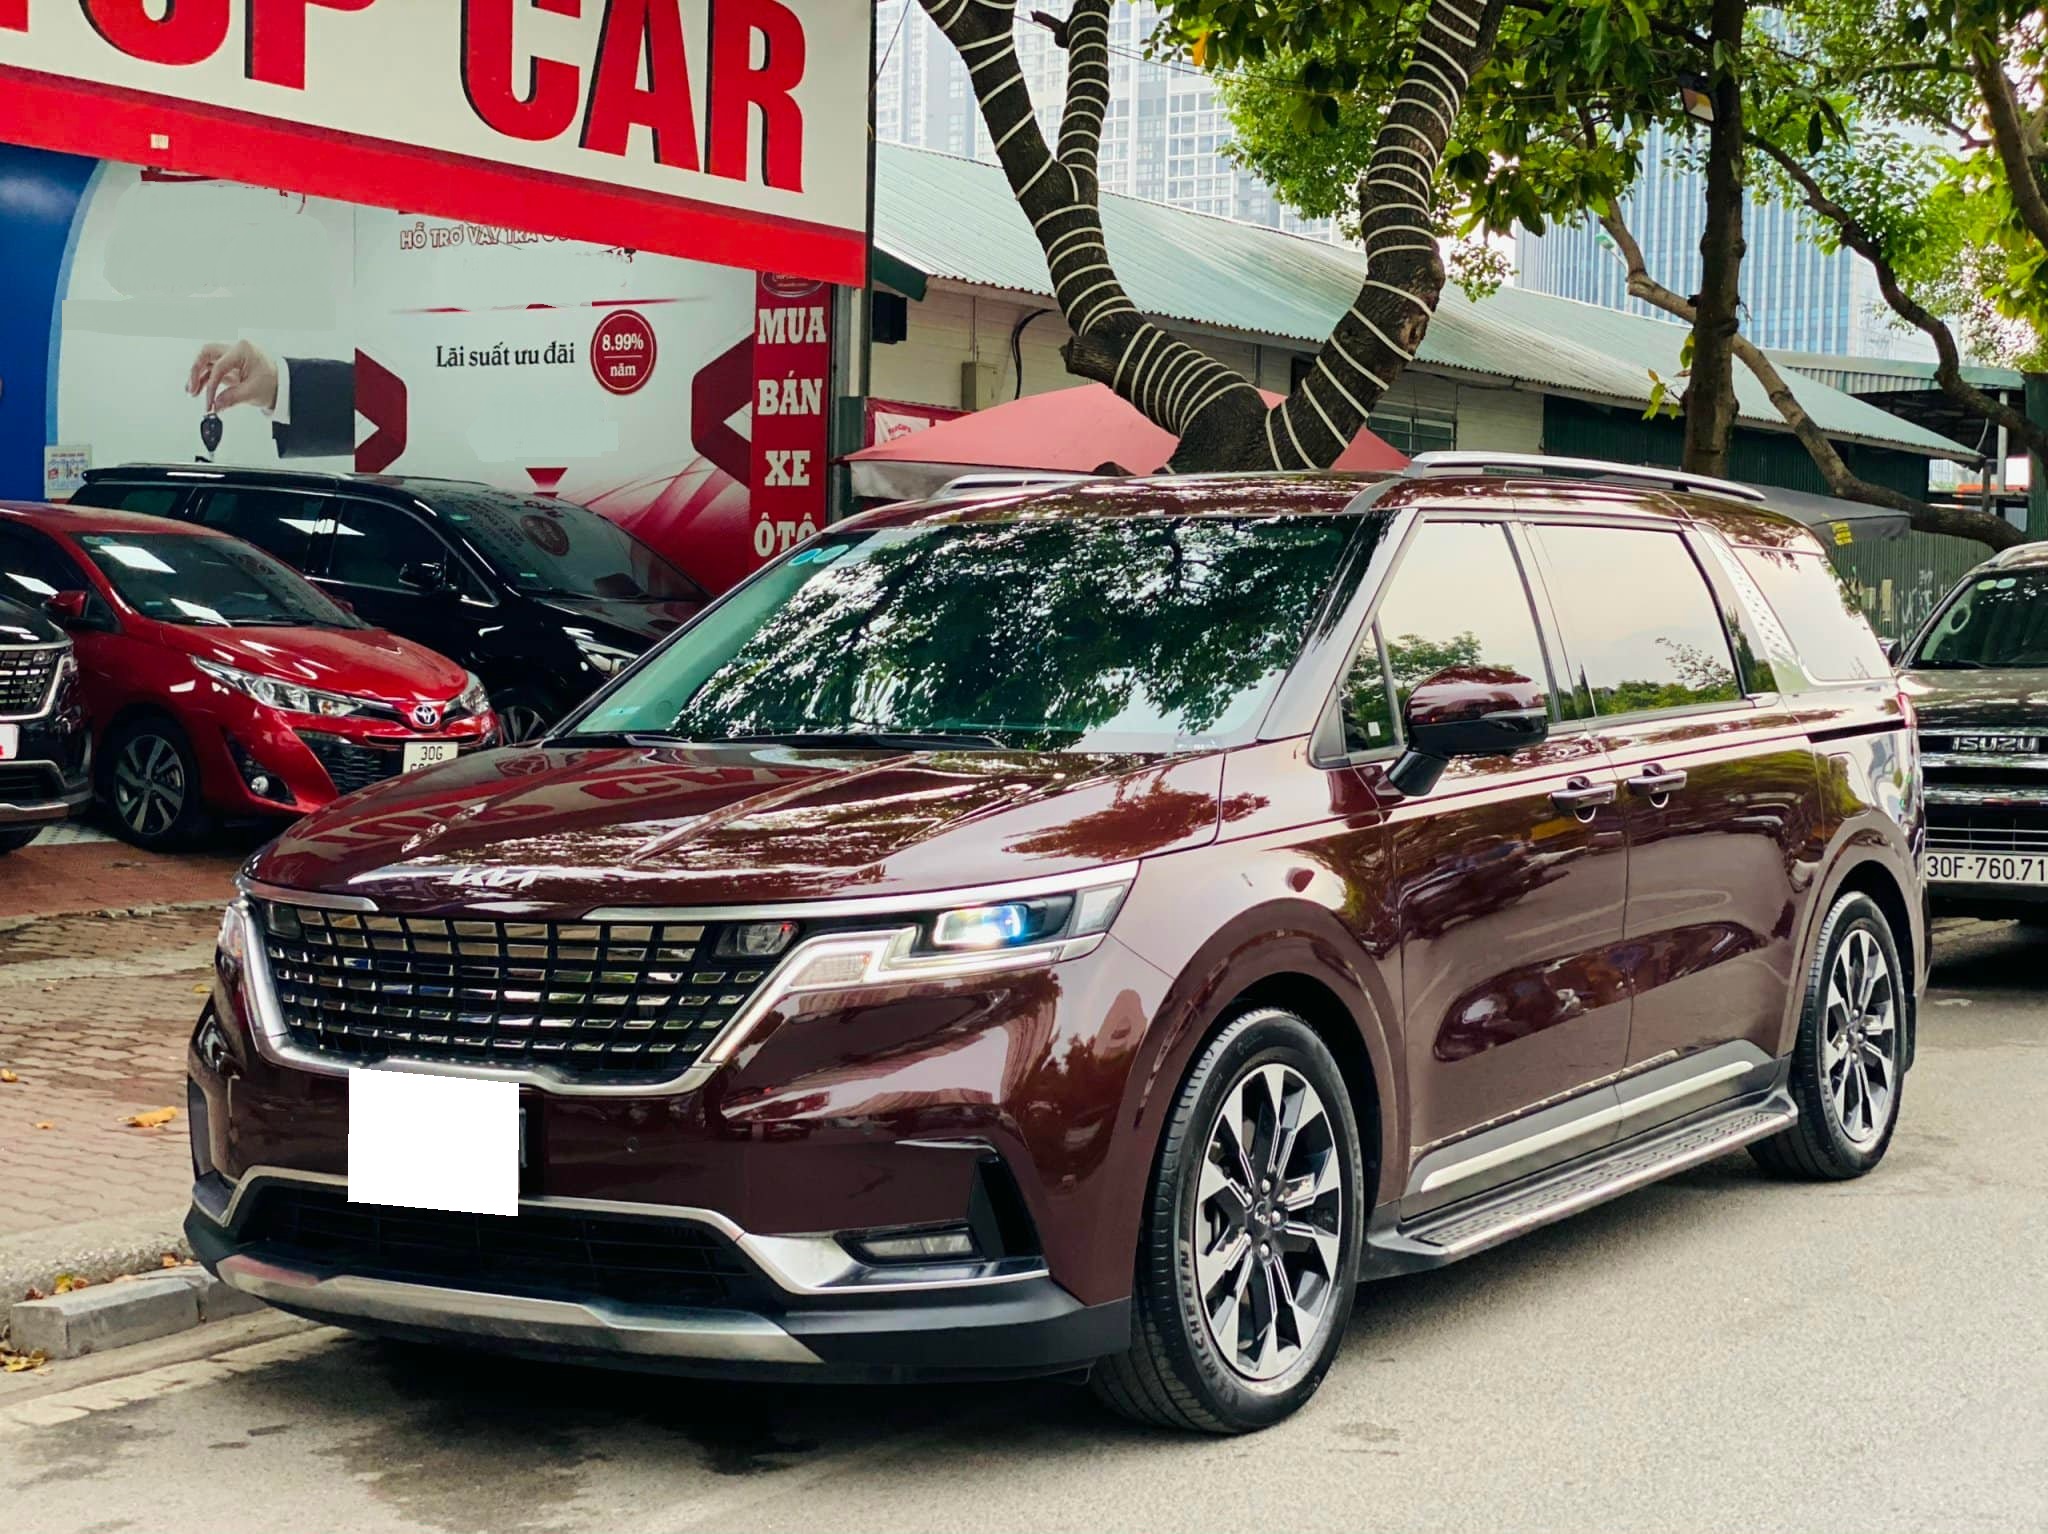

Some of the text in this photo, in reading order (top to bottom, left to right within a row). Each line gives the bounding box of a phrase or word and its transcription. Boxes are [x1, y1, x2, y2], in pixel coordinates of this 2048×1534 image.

[460, 0, 805, 193] CAR
[758, 306, 827, 345] MUA
[468, 341, 509, 367] suất
[514, 349, 540, 364] ưu
[601, 333, 644, 352] 8.99%
[610, 363, 637, 377] năm
[757, 369, 823, 416] BÁN
[764, 449, 811, 487] XE
[420, 746, 443, 761] 30G
[1951, 736, 2040, 752] ISUZU
[1926, 855, 2046, 882] 30F-760.71
